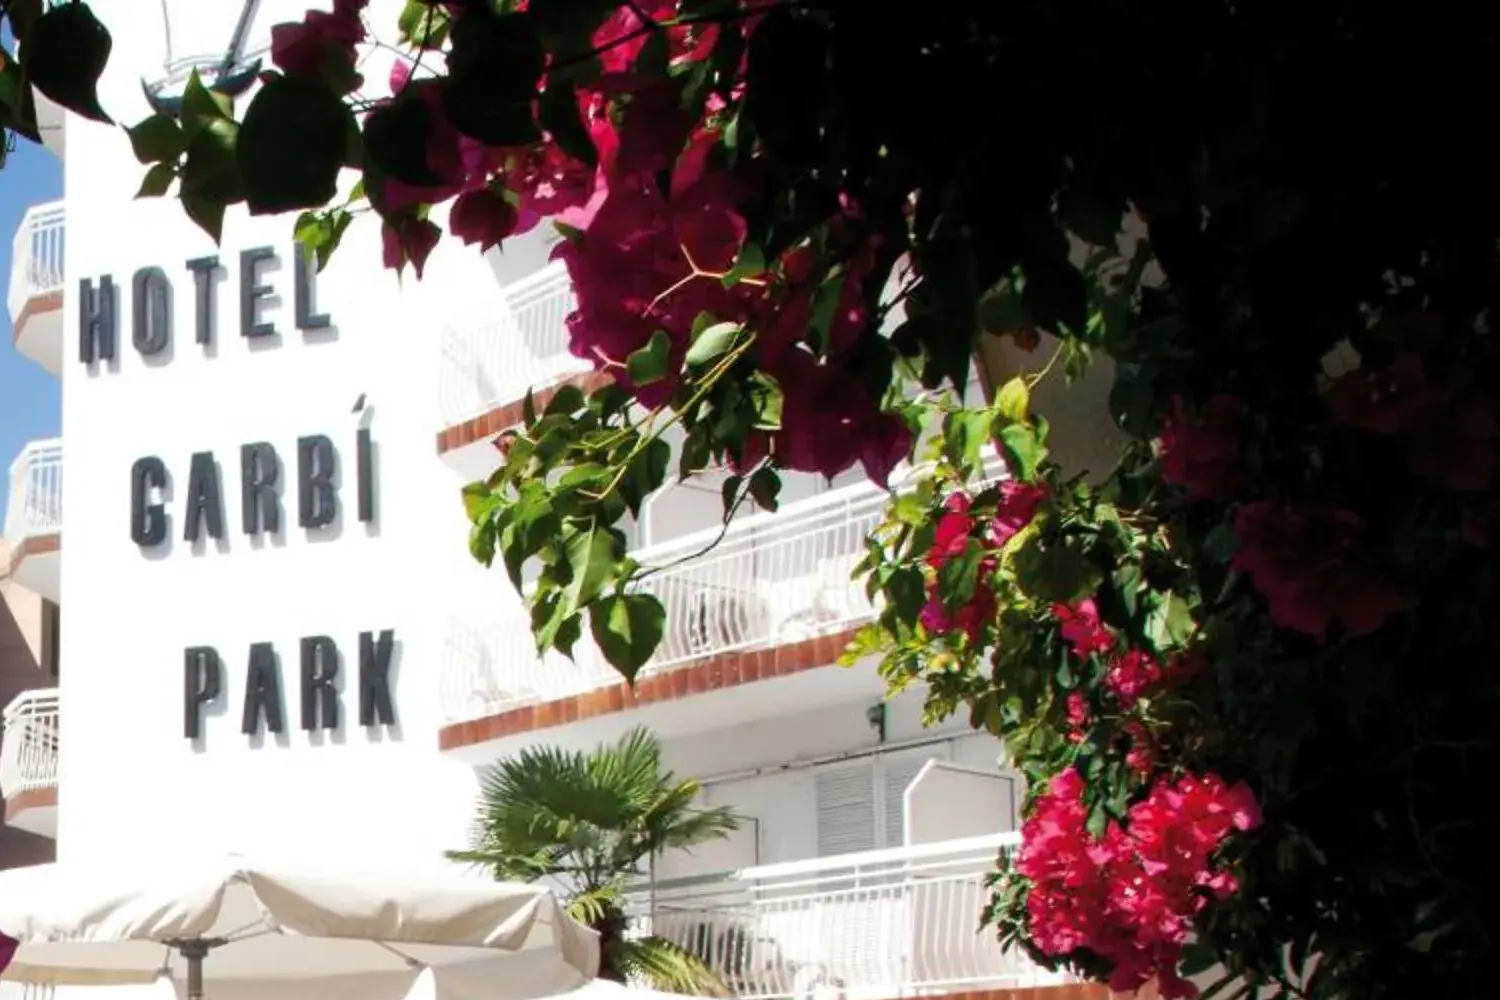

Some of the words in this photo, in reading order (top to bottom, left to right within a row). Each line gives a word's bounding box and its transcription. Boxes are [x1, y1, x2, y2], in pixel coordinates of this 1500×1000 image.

[78, 240, 332, 364] HOTEL
[130, 392, 374, 548] GARBÍ
[183, 628, 396, 739] PARK
